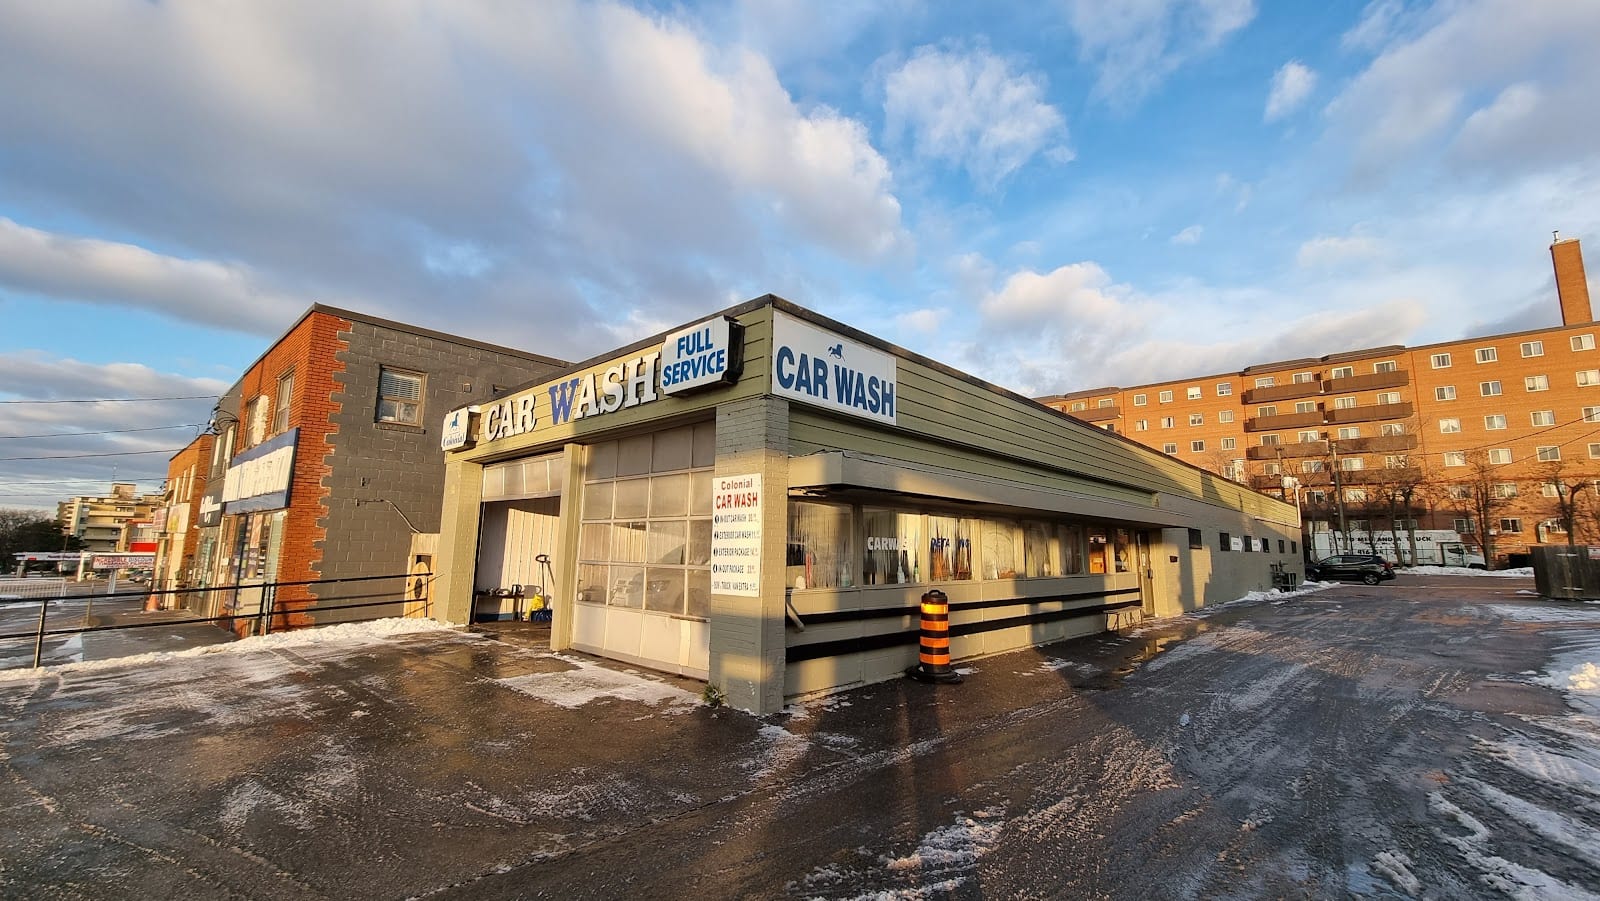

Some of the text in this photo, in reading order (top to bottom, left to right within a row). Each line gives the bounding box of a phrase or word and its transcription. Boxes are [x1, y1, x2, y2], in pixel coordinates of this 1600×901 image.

[677, 327, 713, 359] FULL
[662, 349, 725, 387] SERVICE
[776, 345, 894, 418] CAR WASH
[484, 351, 660, 442] CAR WASH
[721, 478, 753, 491] Colonial
[716, 491, 758, 510] CAR WASH
[718, 547, 734, 557] EXTERIOR
[734, 547, 749, 557] PACKAGE
[867, 536, 970, 551] CARWS DETANG
[729, 564, 744, 574] PACKAGE
[738, 582, 749, 591] EXTRA
